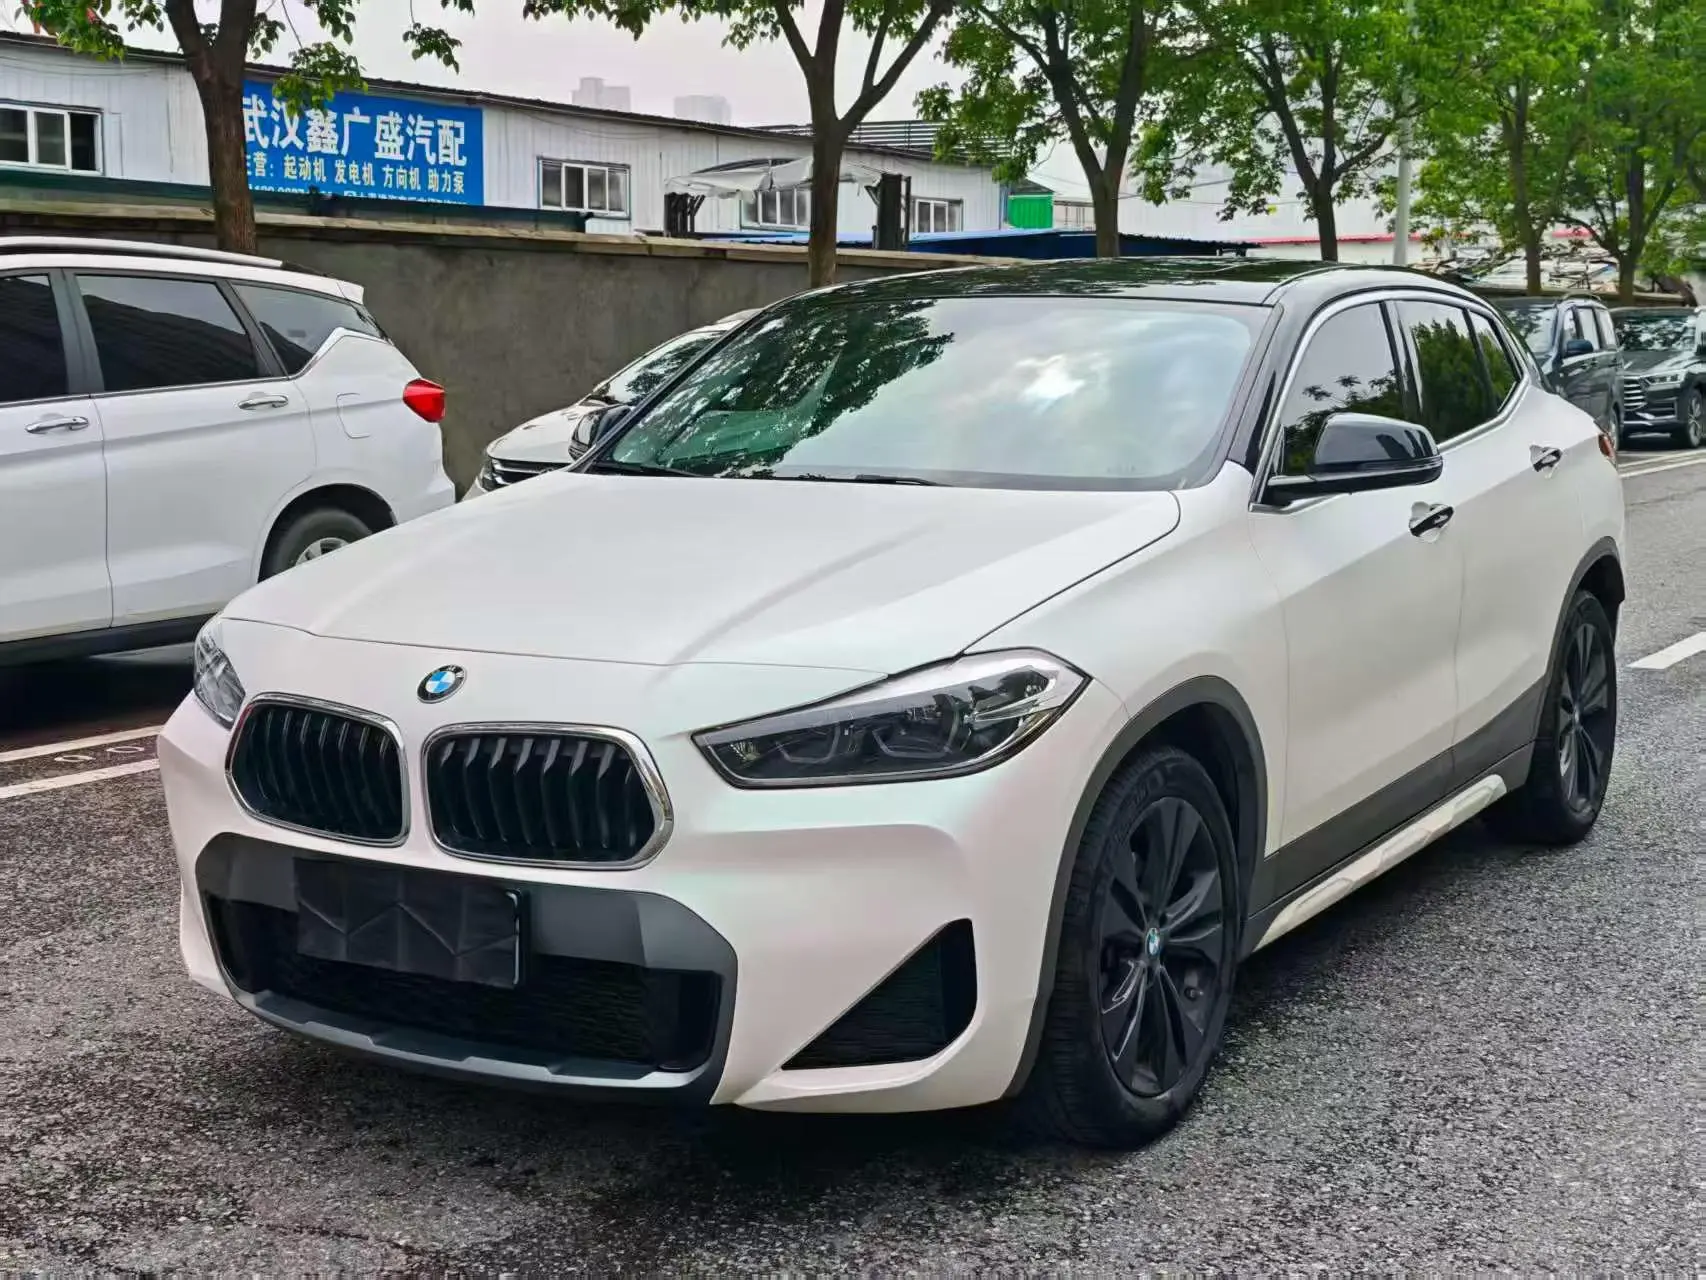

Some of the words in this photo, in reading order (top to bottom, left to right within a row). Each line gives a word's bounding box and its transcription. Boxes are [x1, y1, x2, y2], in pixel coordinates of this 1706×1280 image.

[242, 94, 467, 167] 武汉鑫广盛汽配
[283, 154, 326, 183] 起动机
[334, 159, 375, 185] 发电机
[382, 164, 421, 191] 方向机
[427, 168, 465, 195] 助力泵
